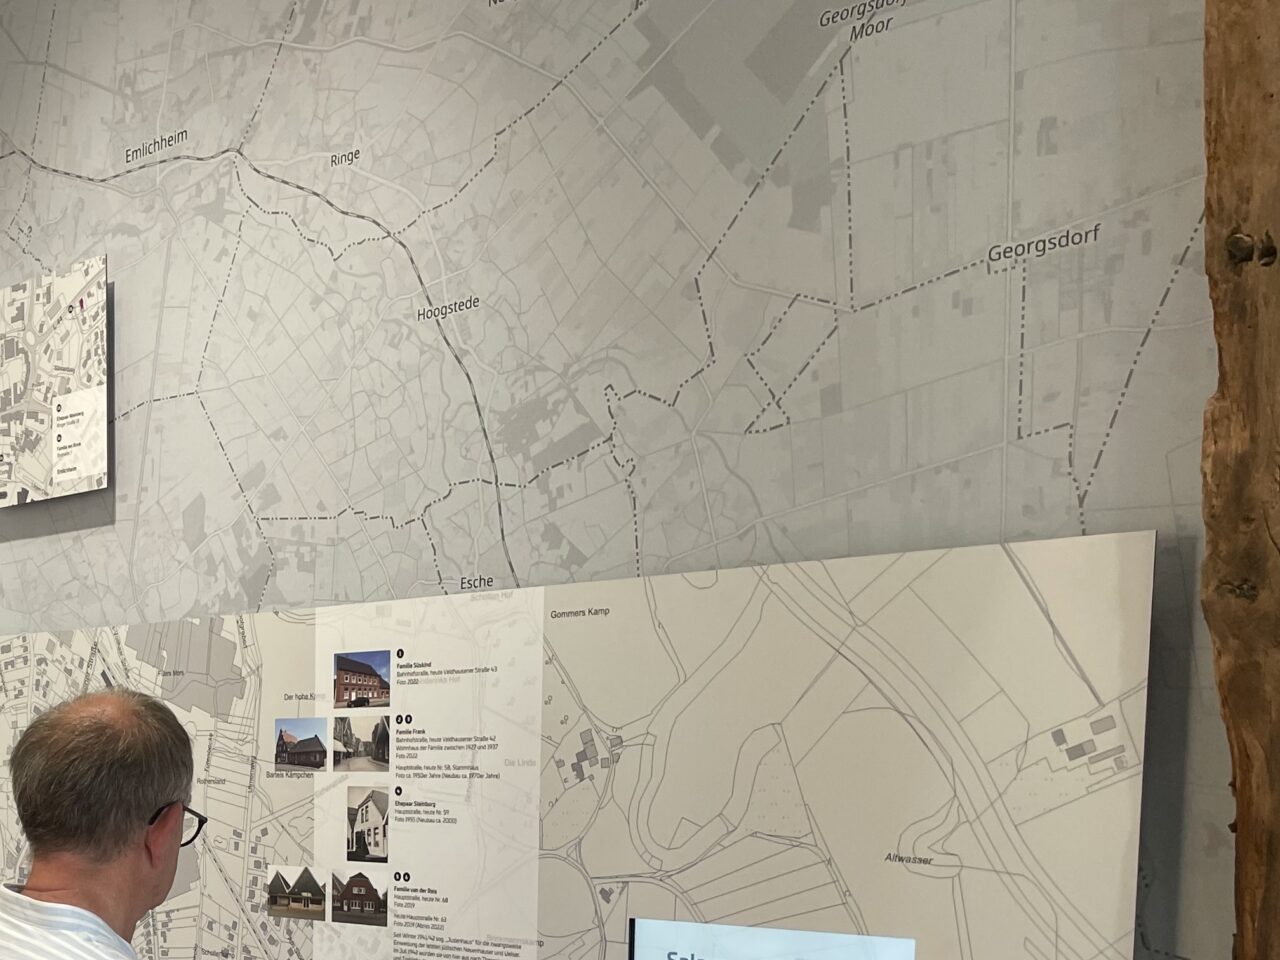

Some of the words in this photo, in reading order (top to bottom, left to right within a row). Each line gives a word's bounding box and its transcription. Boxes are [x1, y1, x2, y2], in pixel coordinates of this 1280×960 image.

[820, 0, 906, 27] Georgsdo
[850, 17, 893, 41] Moor
[125, 129, 188, 163] Emlichheim
[330, 148, 361, 167] Ringe
[987, 224, 1101, 262] Georgsdorf
[418, 296, 480, 321] Hoogstede
[460, 575, 494, 589] Esche
[550, 610, 585, 619] Gommers
[588, 607, 610, 616] Kamp
[884, 853, 934, 865] Altwasser
